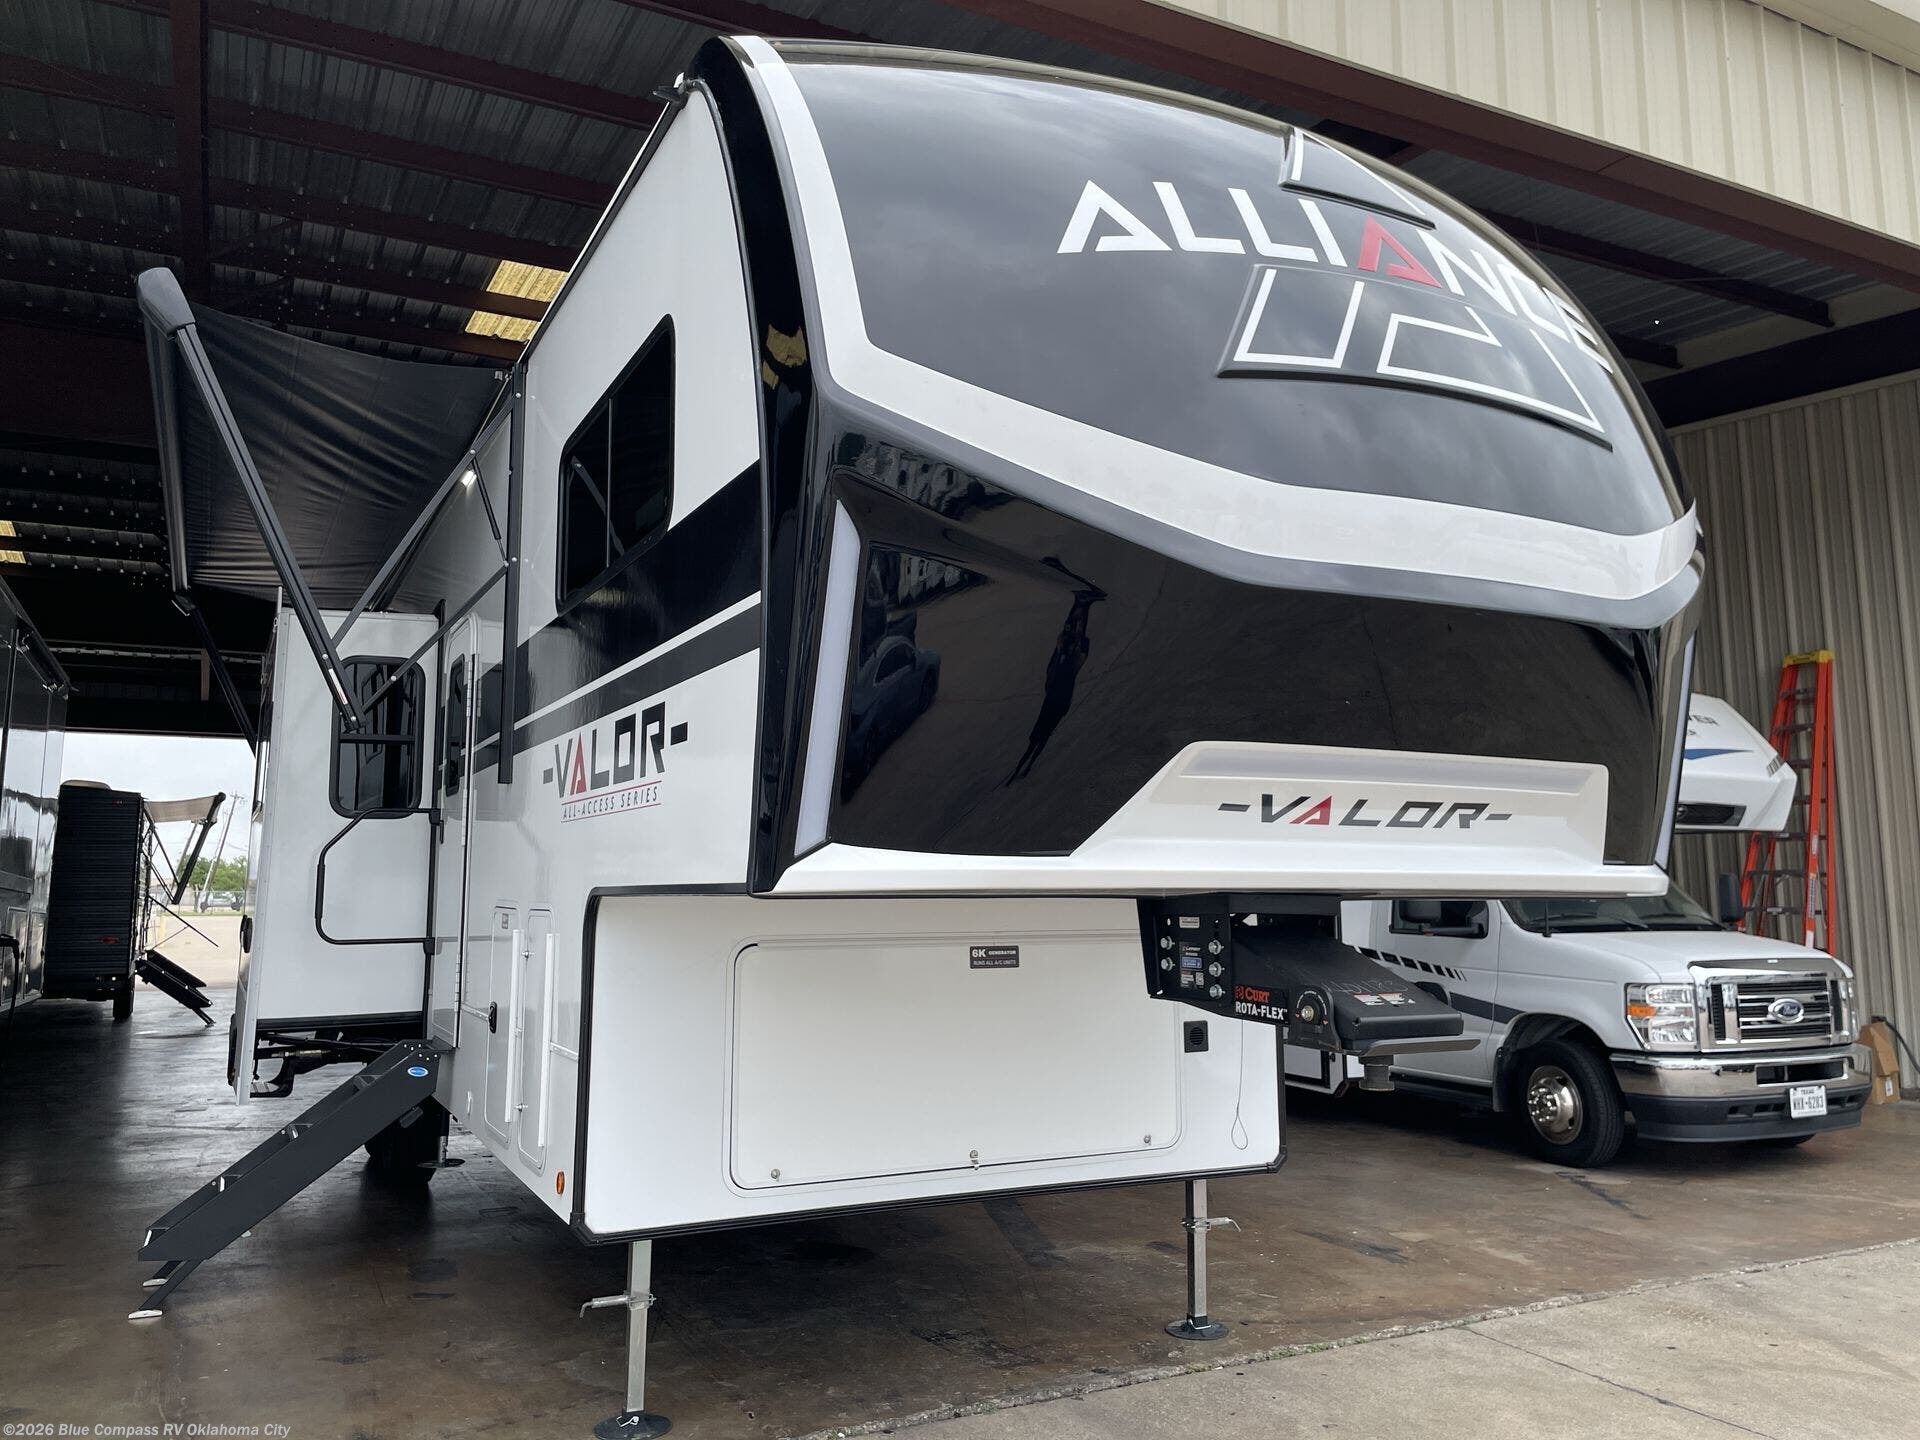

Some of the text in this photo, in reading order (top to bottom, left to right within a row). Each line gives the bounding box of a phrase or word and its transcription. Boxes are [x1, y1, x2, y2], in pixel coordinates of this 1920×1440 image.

[1057, 179, 1614, 375] ALLIANCE
[562, 786, 658, 819] ALL-ACCESS SERIES
[972, 949, 986, 957] 6K
[1244, 986, 1270, 1003] CURT
